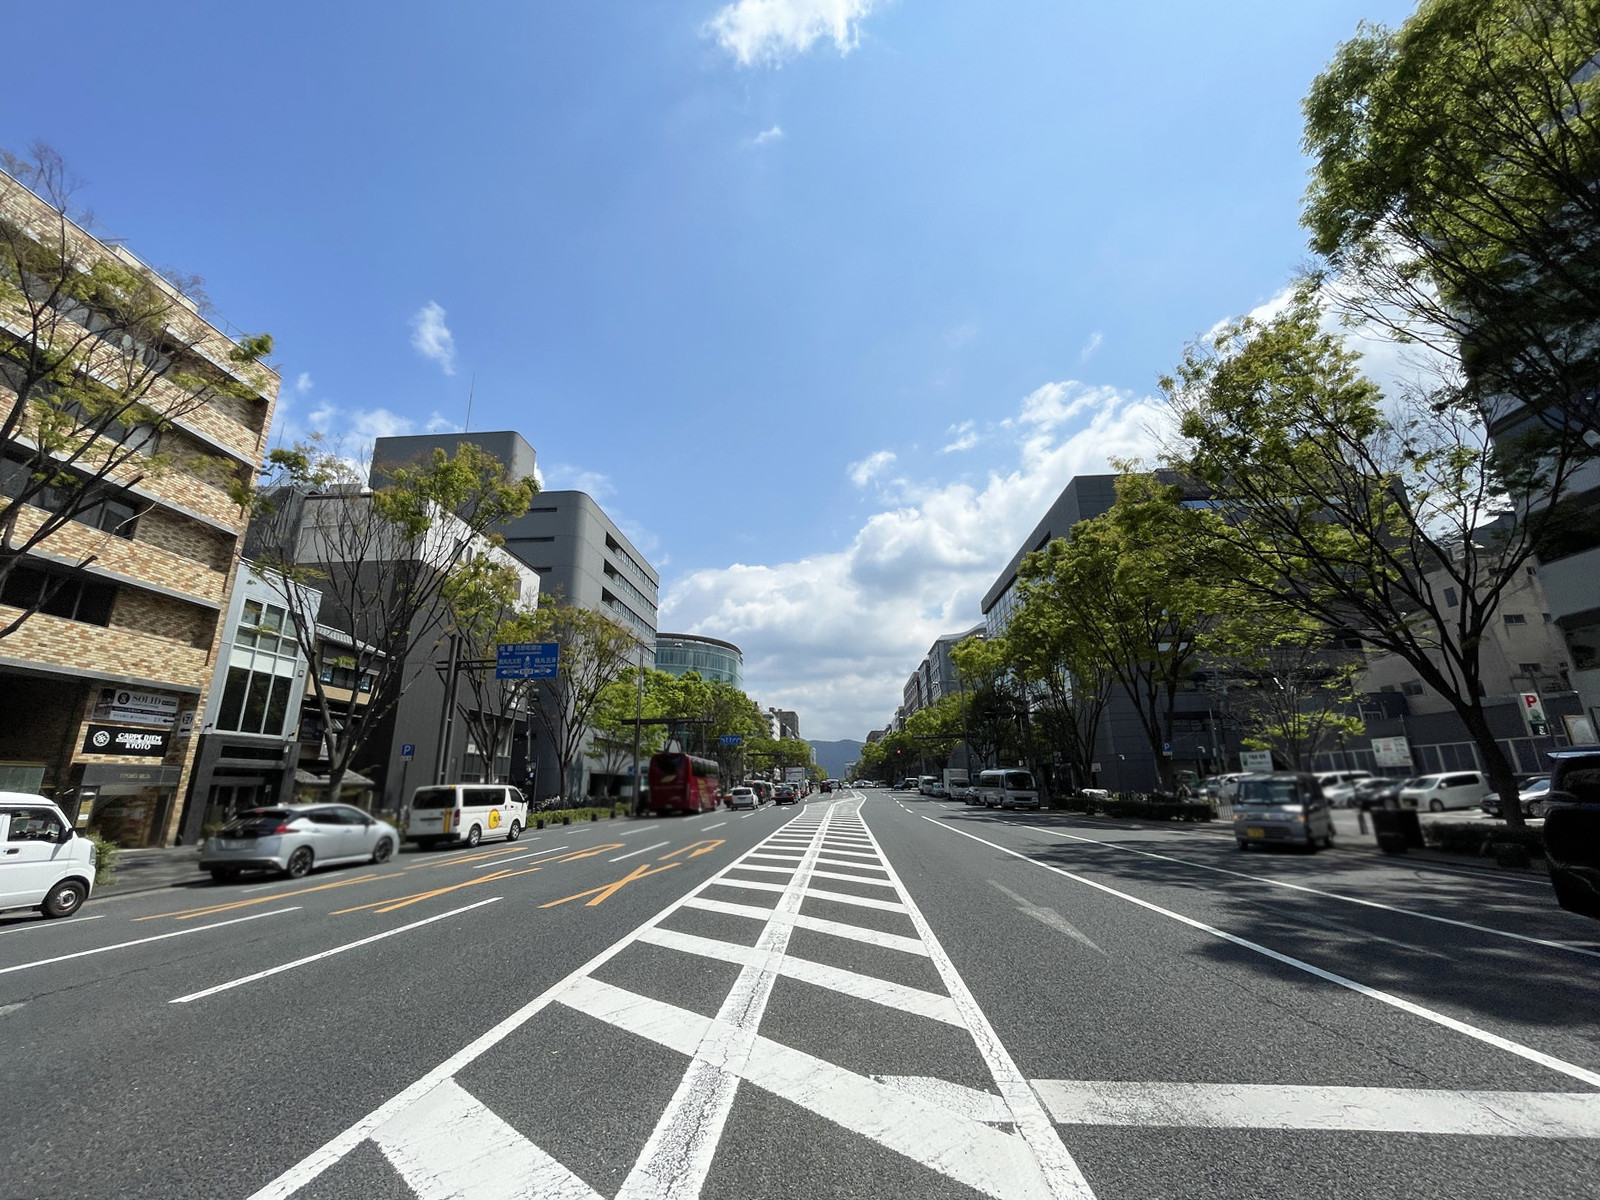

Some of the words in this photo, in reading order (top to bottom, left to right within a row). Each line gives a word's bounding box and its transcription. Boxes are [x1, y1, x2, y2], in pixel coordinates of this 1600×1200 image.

[133, 695, 161, 705] SOLID
[1524, 695, 1537, 708] P
[117, 732, 143, 741] CARPE
[143, 734, 162, 742] DIEM
[125, 742, 151, 750] KYOTO
[404, 745, 411, 755] P
